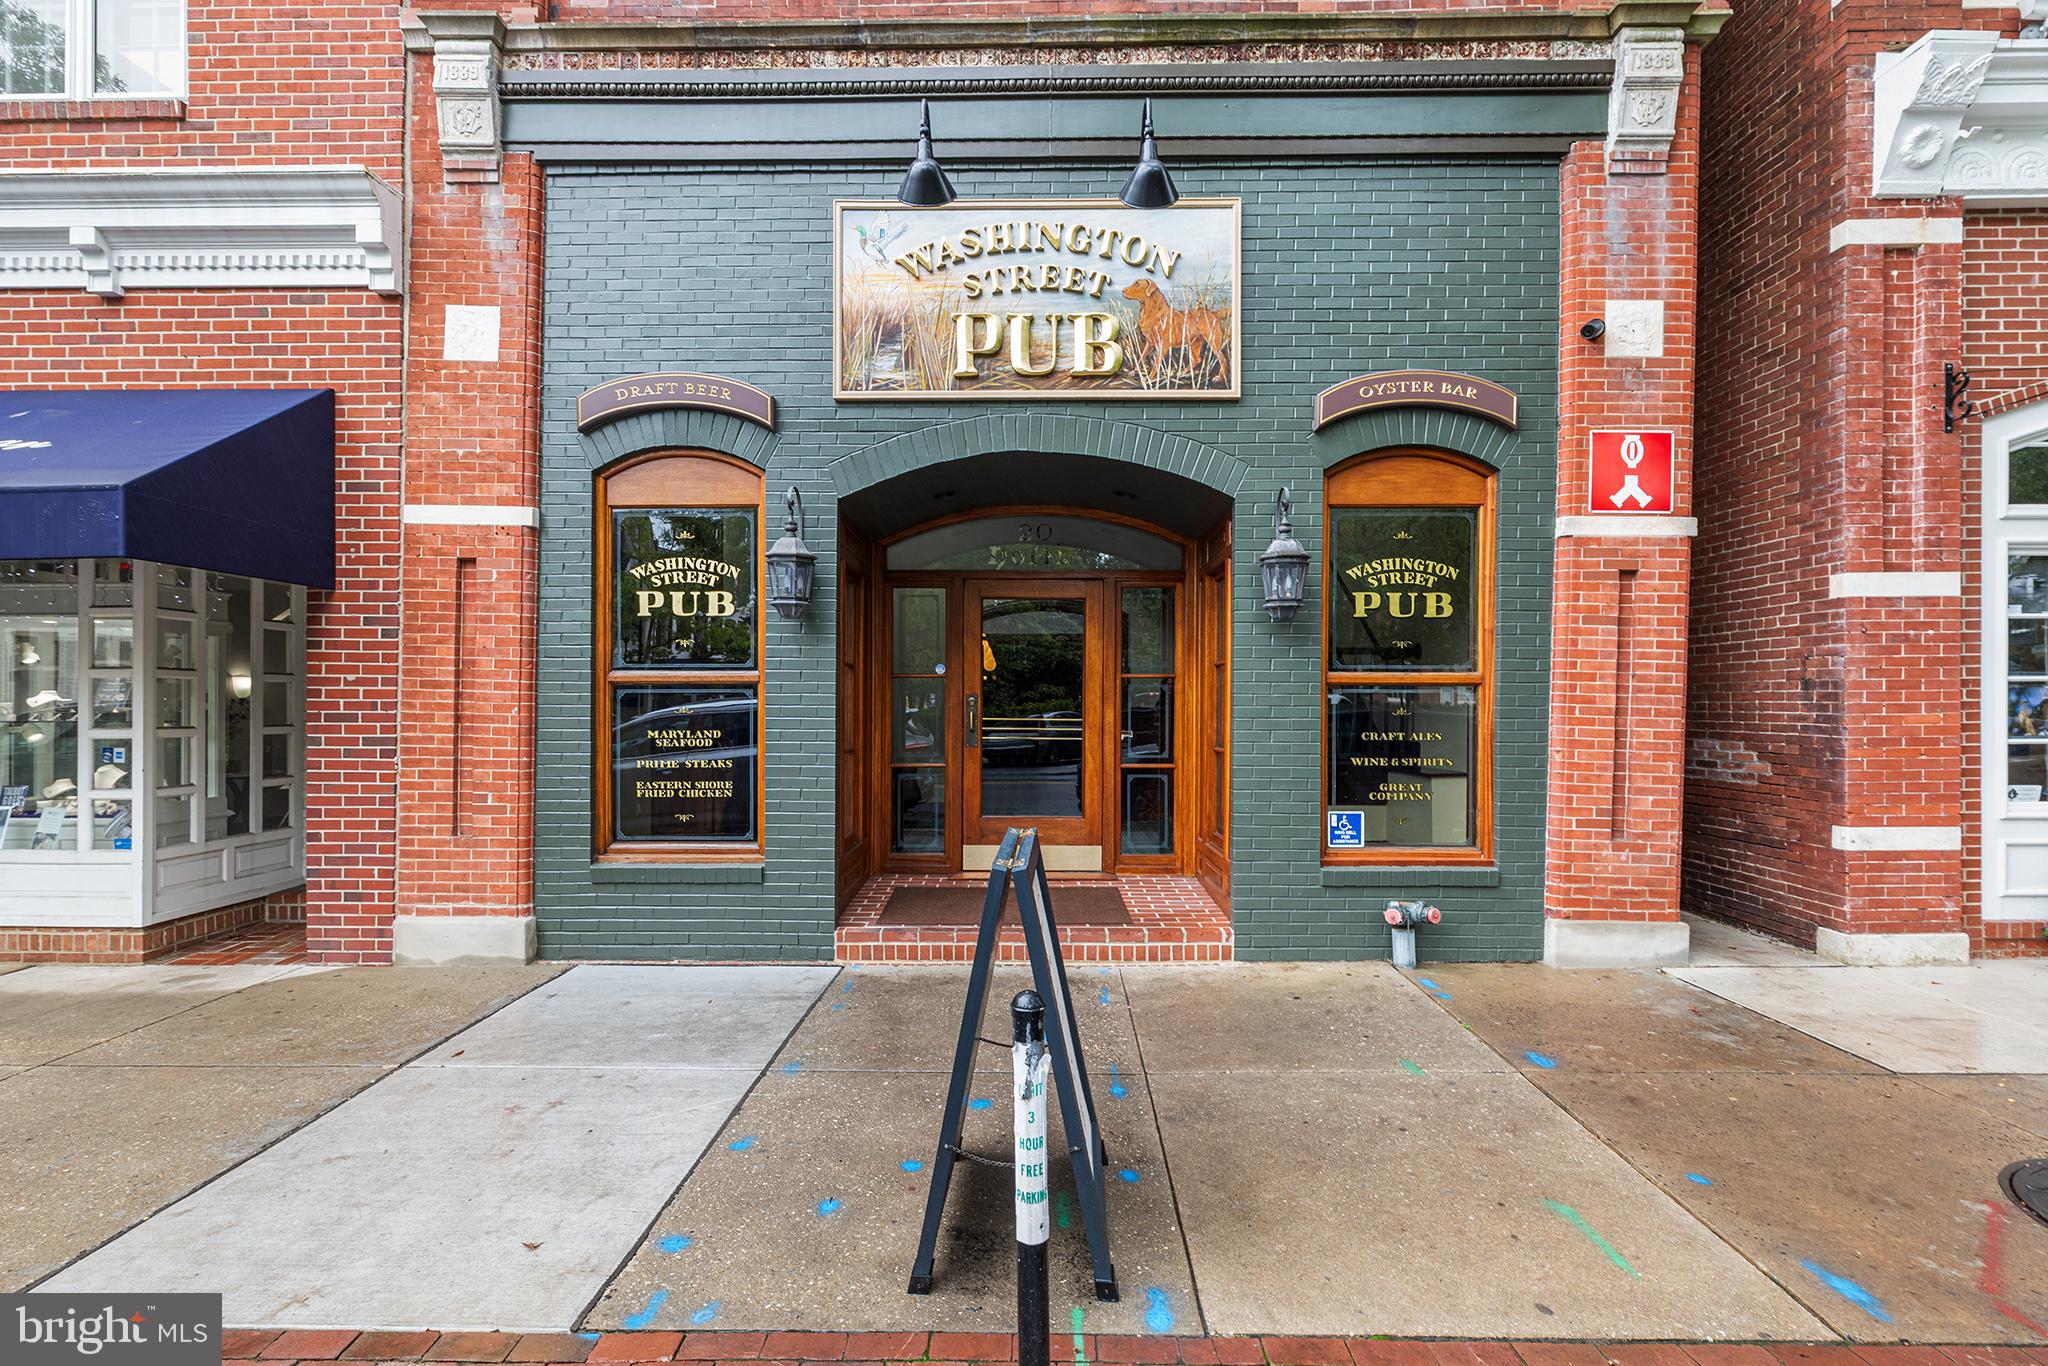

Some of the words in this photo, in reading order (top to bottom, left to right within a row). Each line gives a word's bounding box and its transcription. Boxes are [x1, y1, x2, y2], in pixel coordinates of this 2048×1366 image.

[894, 220, 1182, 280] WASHINGTON
[962, 263, 1113, 299] STREET
[951, 311, 1125, 378] PUB
[615, 382, 678, 401] DRAFT
[684, 382, 732, 400] BEER
[1359, 381, 1435, 399] OYSTER
[1441, 382, 1478, 400] BAR
[629, 557, 741, 581] WASHINGTON
[1345, 557, 1460, 582] WASHINGTON
[650, 570, 720, 588] STREET
[1367, 571, 1438, 589] STREET
[635, 590, 736, 618] PUB
[1351, 591, 1455, 619] PUB
[647, 729, 722, 739] MARYLAND
[1360, 731, 1406, 741] CRAFT
[1409, 732, 1442, 741] ALES
[655, 738, 713, 747] SEAFOOD
[636, 759, 679, 769] PRIME
[685, 759, 733, 769] STEAKS
[1350, 757, 1388, 767] WINE
[1391, 757, 1399, 767] &
[1401, 757, 1454, 767] SPIRITS
[636, 780, 692, 790] EASTERN
[694, 780, 733, 790] SHORE
[1379, 783, 1423, 792] GREAT
[636, 789, 675, 798] FRIED
[678, 789, 733, 798] CHICKEN
[1368, 791, 1434, 801] COMPANY
[1018, 1082, 1044, 1098] LIT
[1027, 1111, 1036, 1125] 3
[1019, 1135, 1044, 1152] HOUR
[1020, 1163, 1044, 1179] FREE
